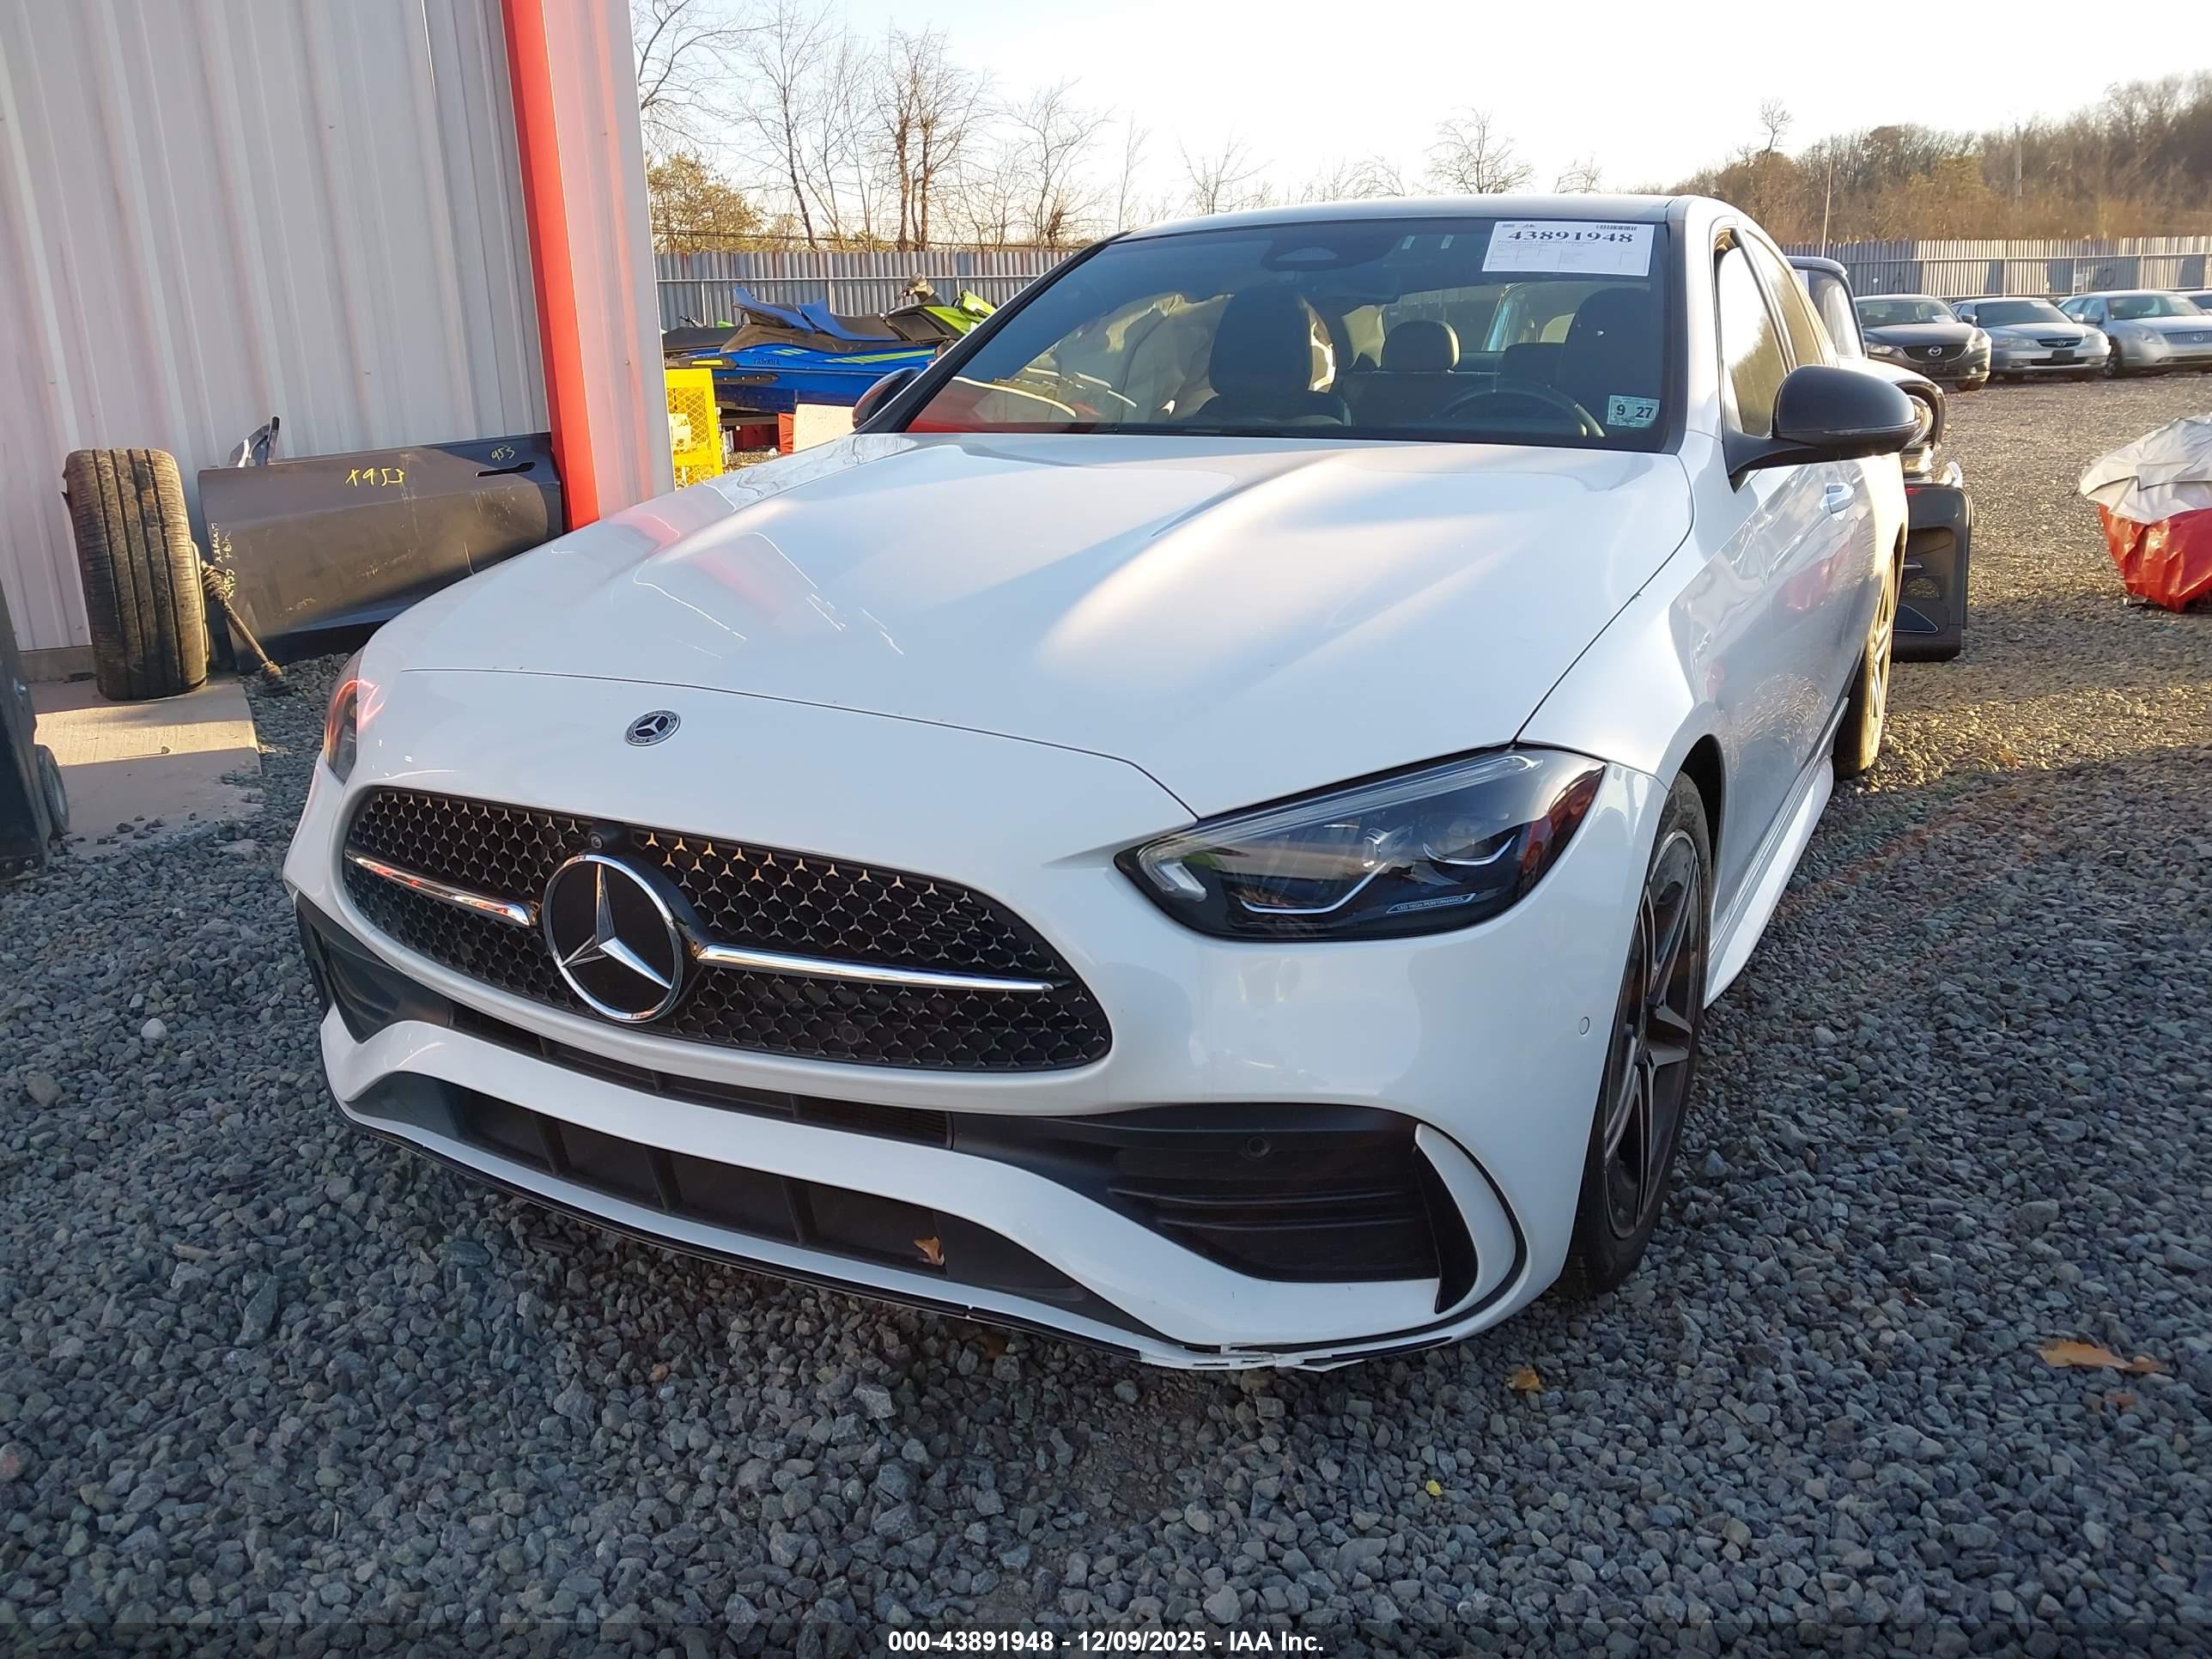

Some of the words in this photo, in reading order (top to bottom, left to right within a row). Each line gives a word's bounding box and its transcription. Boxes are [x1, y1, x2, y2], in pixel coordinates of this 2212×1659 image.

[1508, 230, 1633, 243] 43891948
[1616, 404, 1626, 416] 9
[1635, 406, 1654, 418] 27
